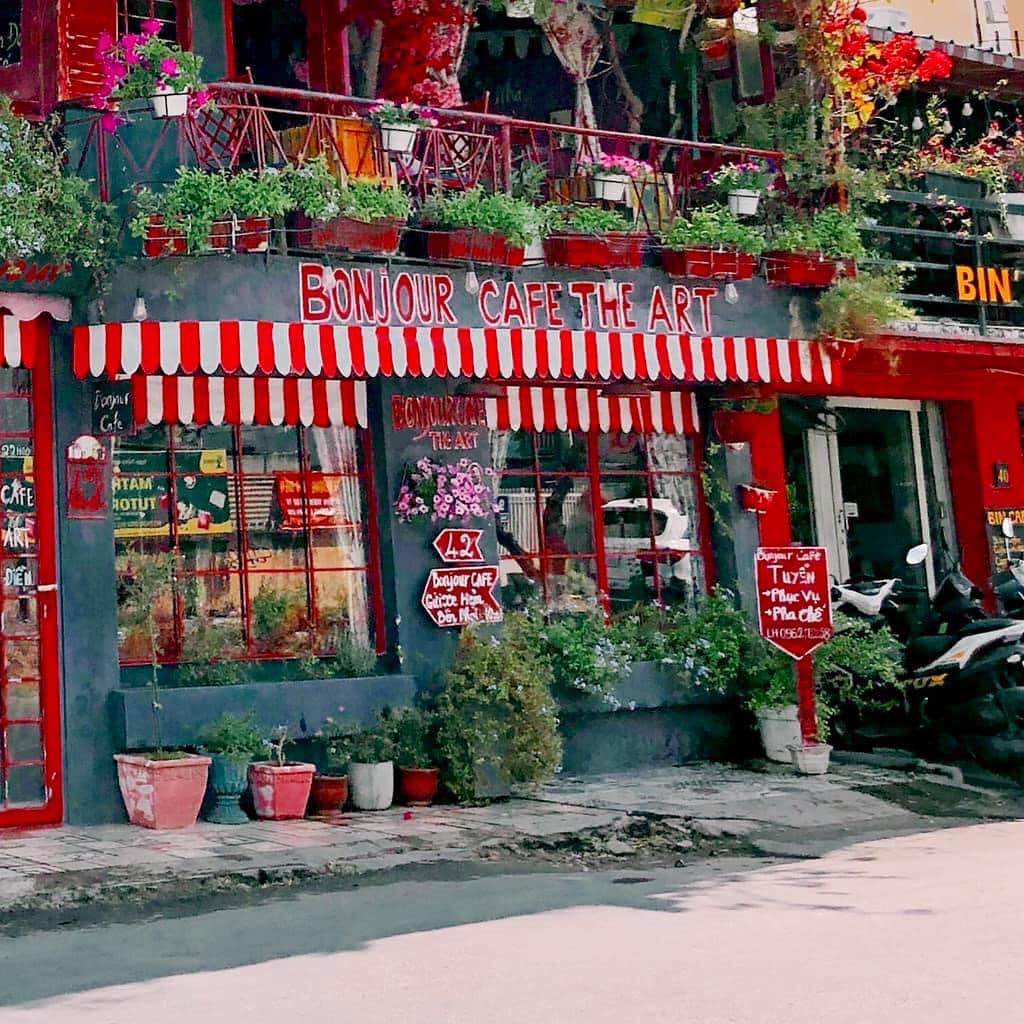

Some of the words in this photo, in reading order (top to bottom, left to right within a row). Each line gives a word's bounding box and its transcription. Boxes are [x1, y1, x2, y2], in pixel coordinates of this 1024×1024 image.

[477, 278, 565, 327] CAFE
[569, 281, 637, 330] THE
[648, 285, 719, 334] ART
[0, 485, 34, 506] CAFE
[3, 527, 30, 548] ART
[445, 532, 474, 558] 42
[471, 573, 493, 587] CAFE
